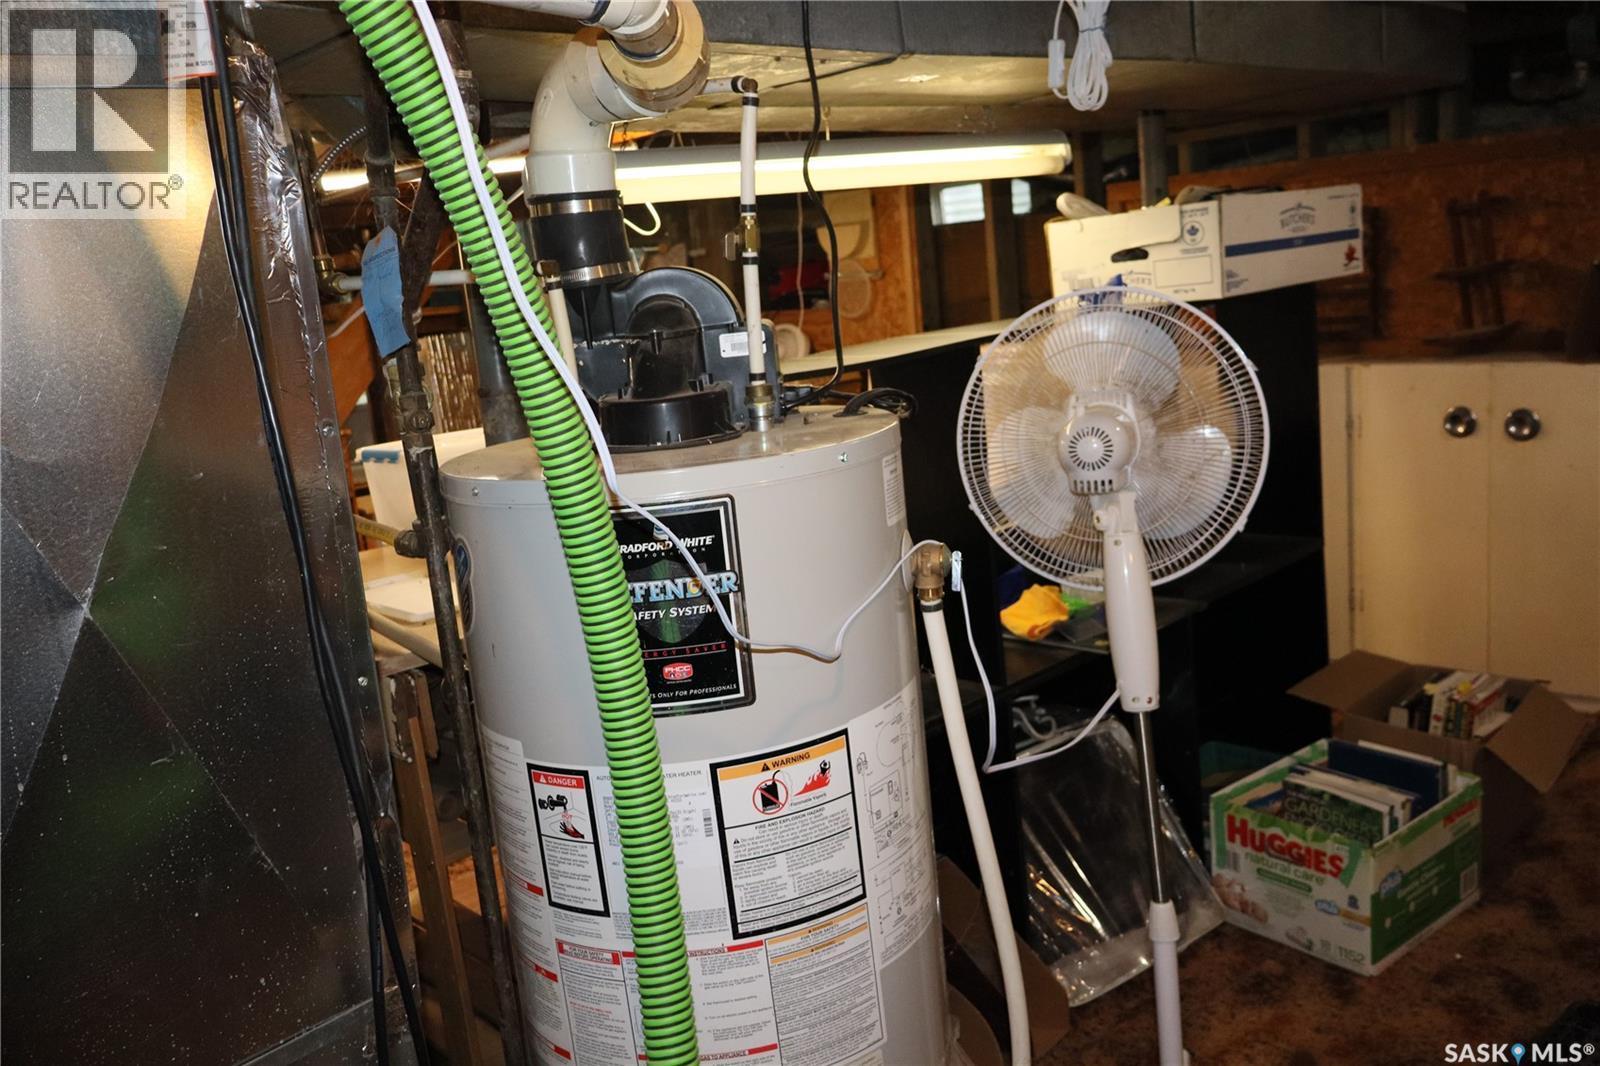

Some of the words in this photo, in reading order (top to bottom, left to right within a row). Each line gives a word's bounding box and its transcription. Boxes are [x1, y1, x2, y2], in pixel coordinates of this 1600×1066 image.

[618, 540, 673, 554] RADFORD
[629, 572, 740, 603] FENDER
[633, 609, 666, 621] AFETY
[669, 604, 716, 618] SYSTEM
[645, 648, 677, 658] ERGY
[685, 643, 728, 654] SAVER
[657, 691, 674, 699] ONLY
[675, 689, 688, 697] FOR
[689, 683, 738, 696] PROFESSIONALS
[771, 751, 811, 769] WARNING
[547, 775, 578, 787] DANGER
[678, 770, 702, 779] HEATER
[689, 946, 726, 957] INSTRUCTIONS
